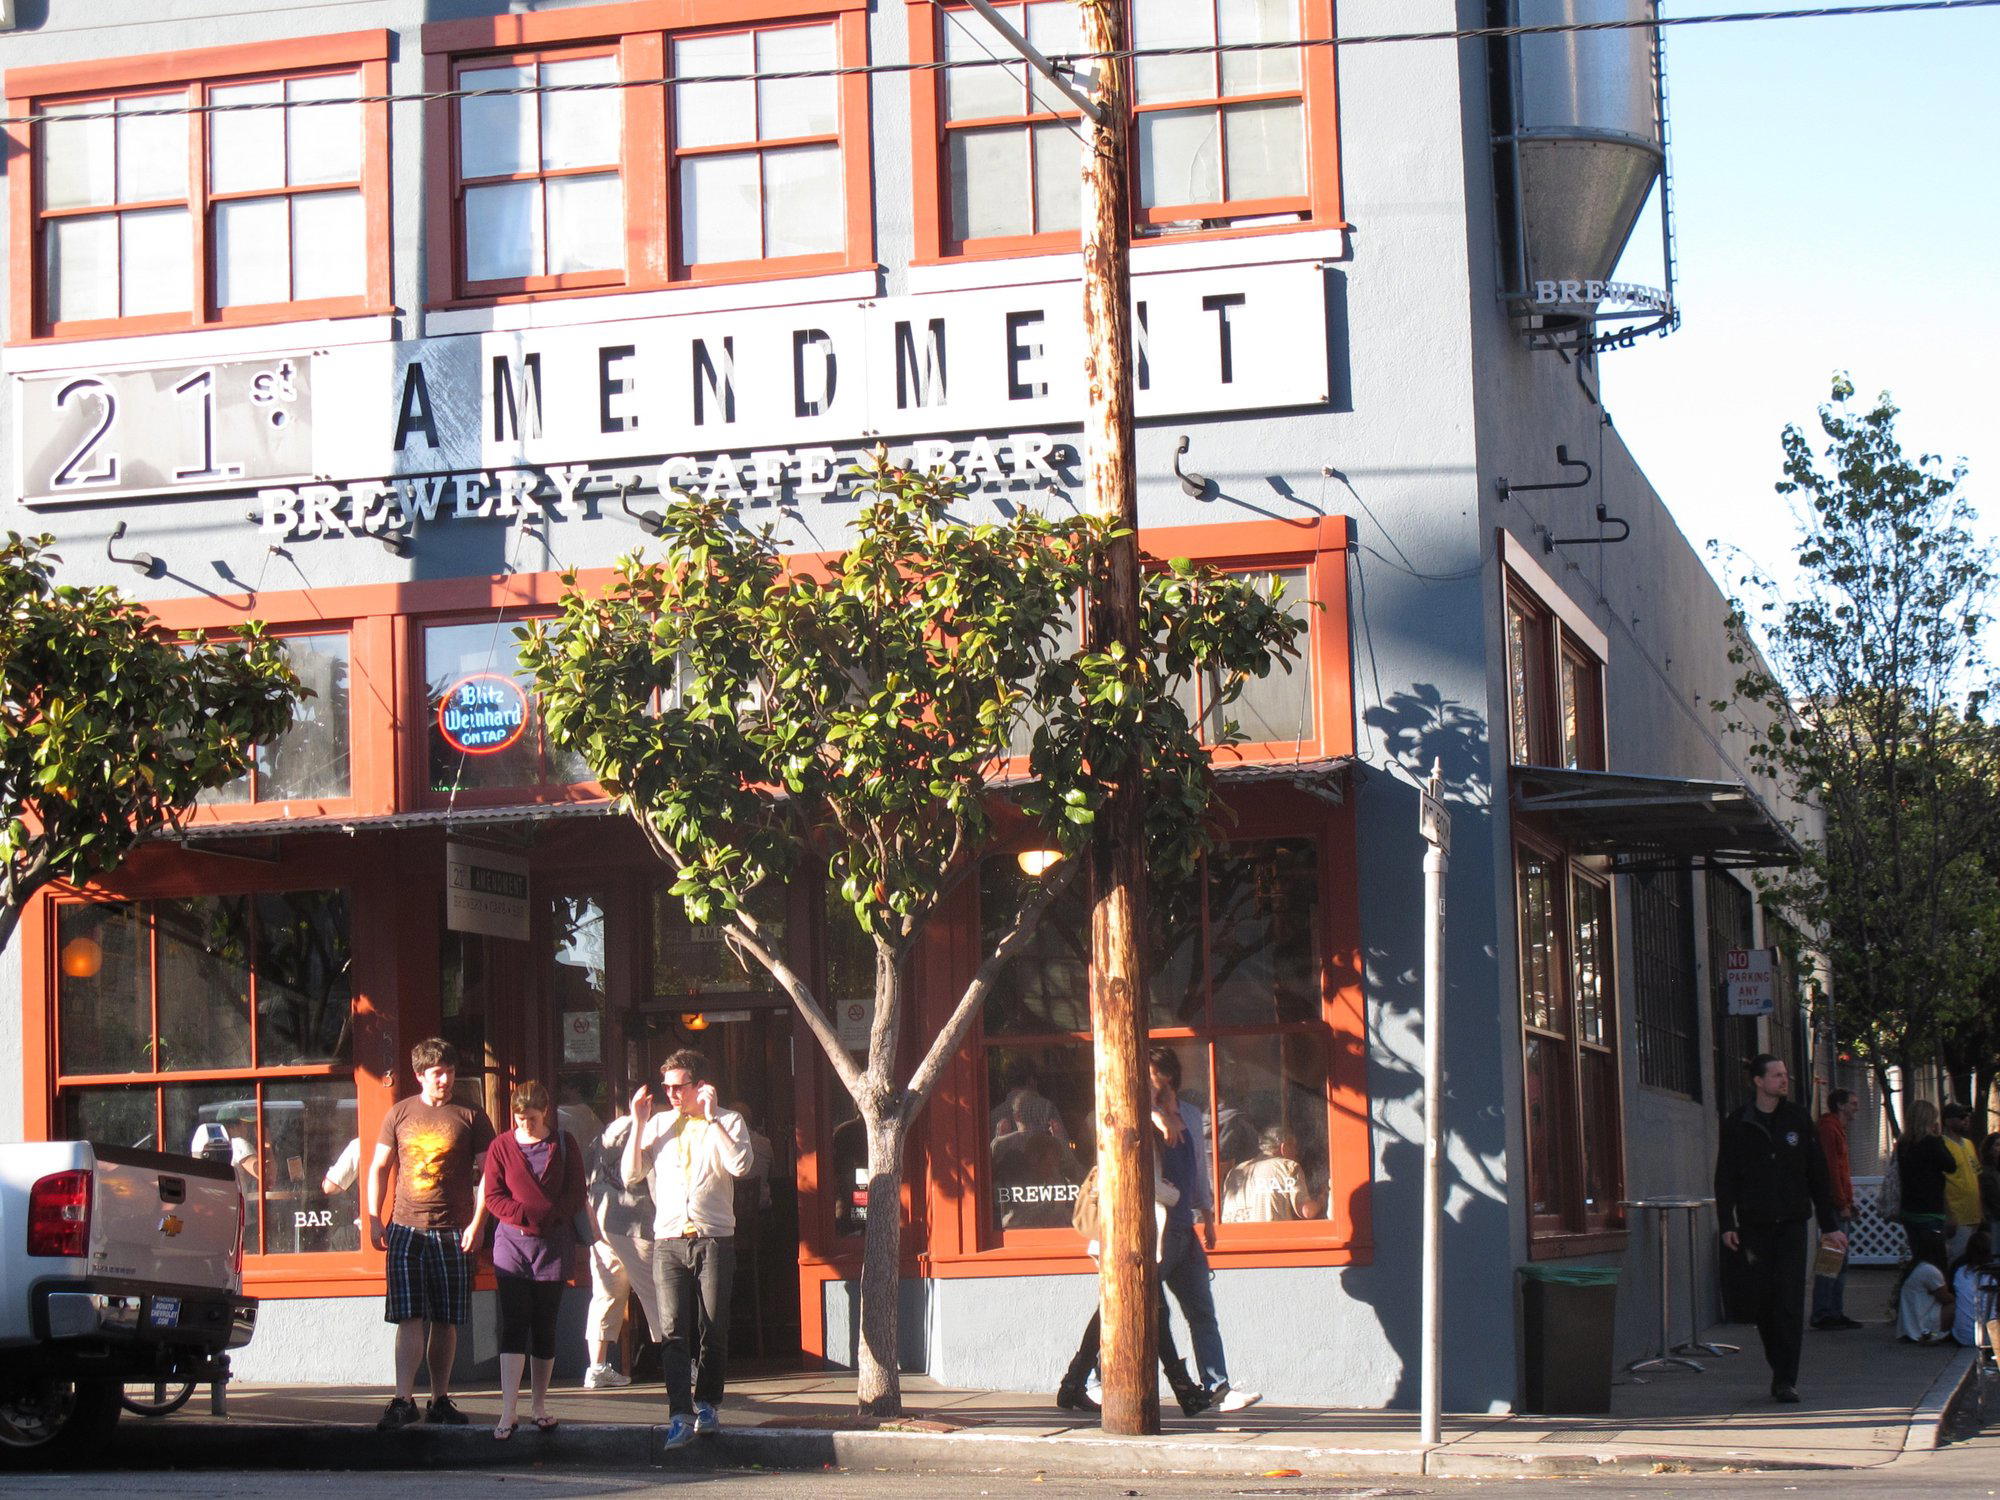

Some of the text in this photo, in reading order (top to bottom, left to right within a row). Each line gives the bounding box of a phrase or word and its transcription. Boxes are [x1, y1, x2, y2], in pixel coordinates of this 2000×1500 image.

[1535, 280, 1671, 314] BREWERY
[257, 432, 1059, 535] BREWERY CAFE BAR
[461, 685, 504, 705] Blitz
[445, 702, 521, 730] Weinhard
[462, 729, 507, 745] ON TAP
[1728, 953, 1747, 967] NO
[1728, 971, 1769, 983] PARKING
[1738, 986, 1759, 997] ANY
[998, 1184, 1080, 1203] BREWER
[294, 1211, 333, 1228] BAR
